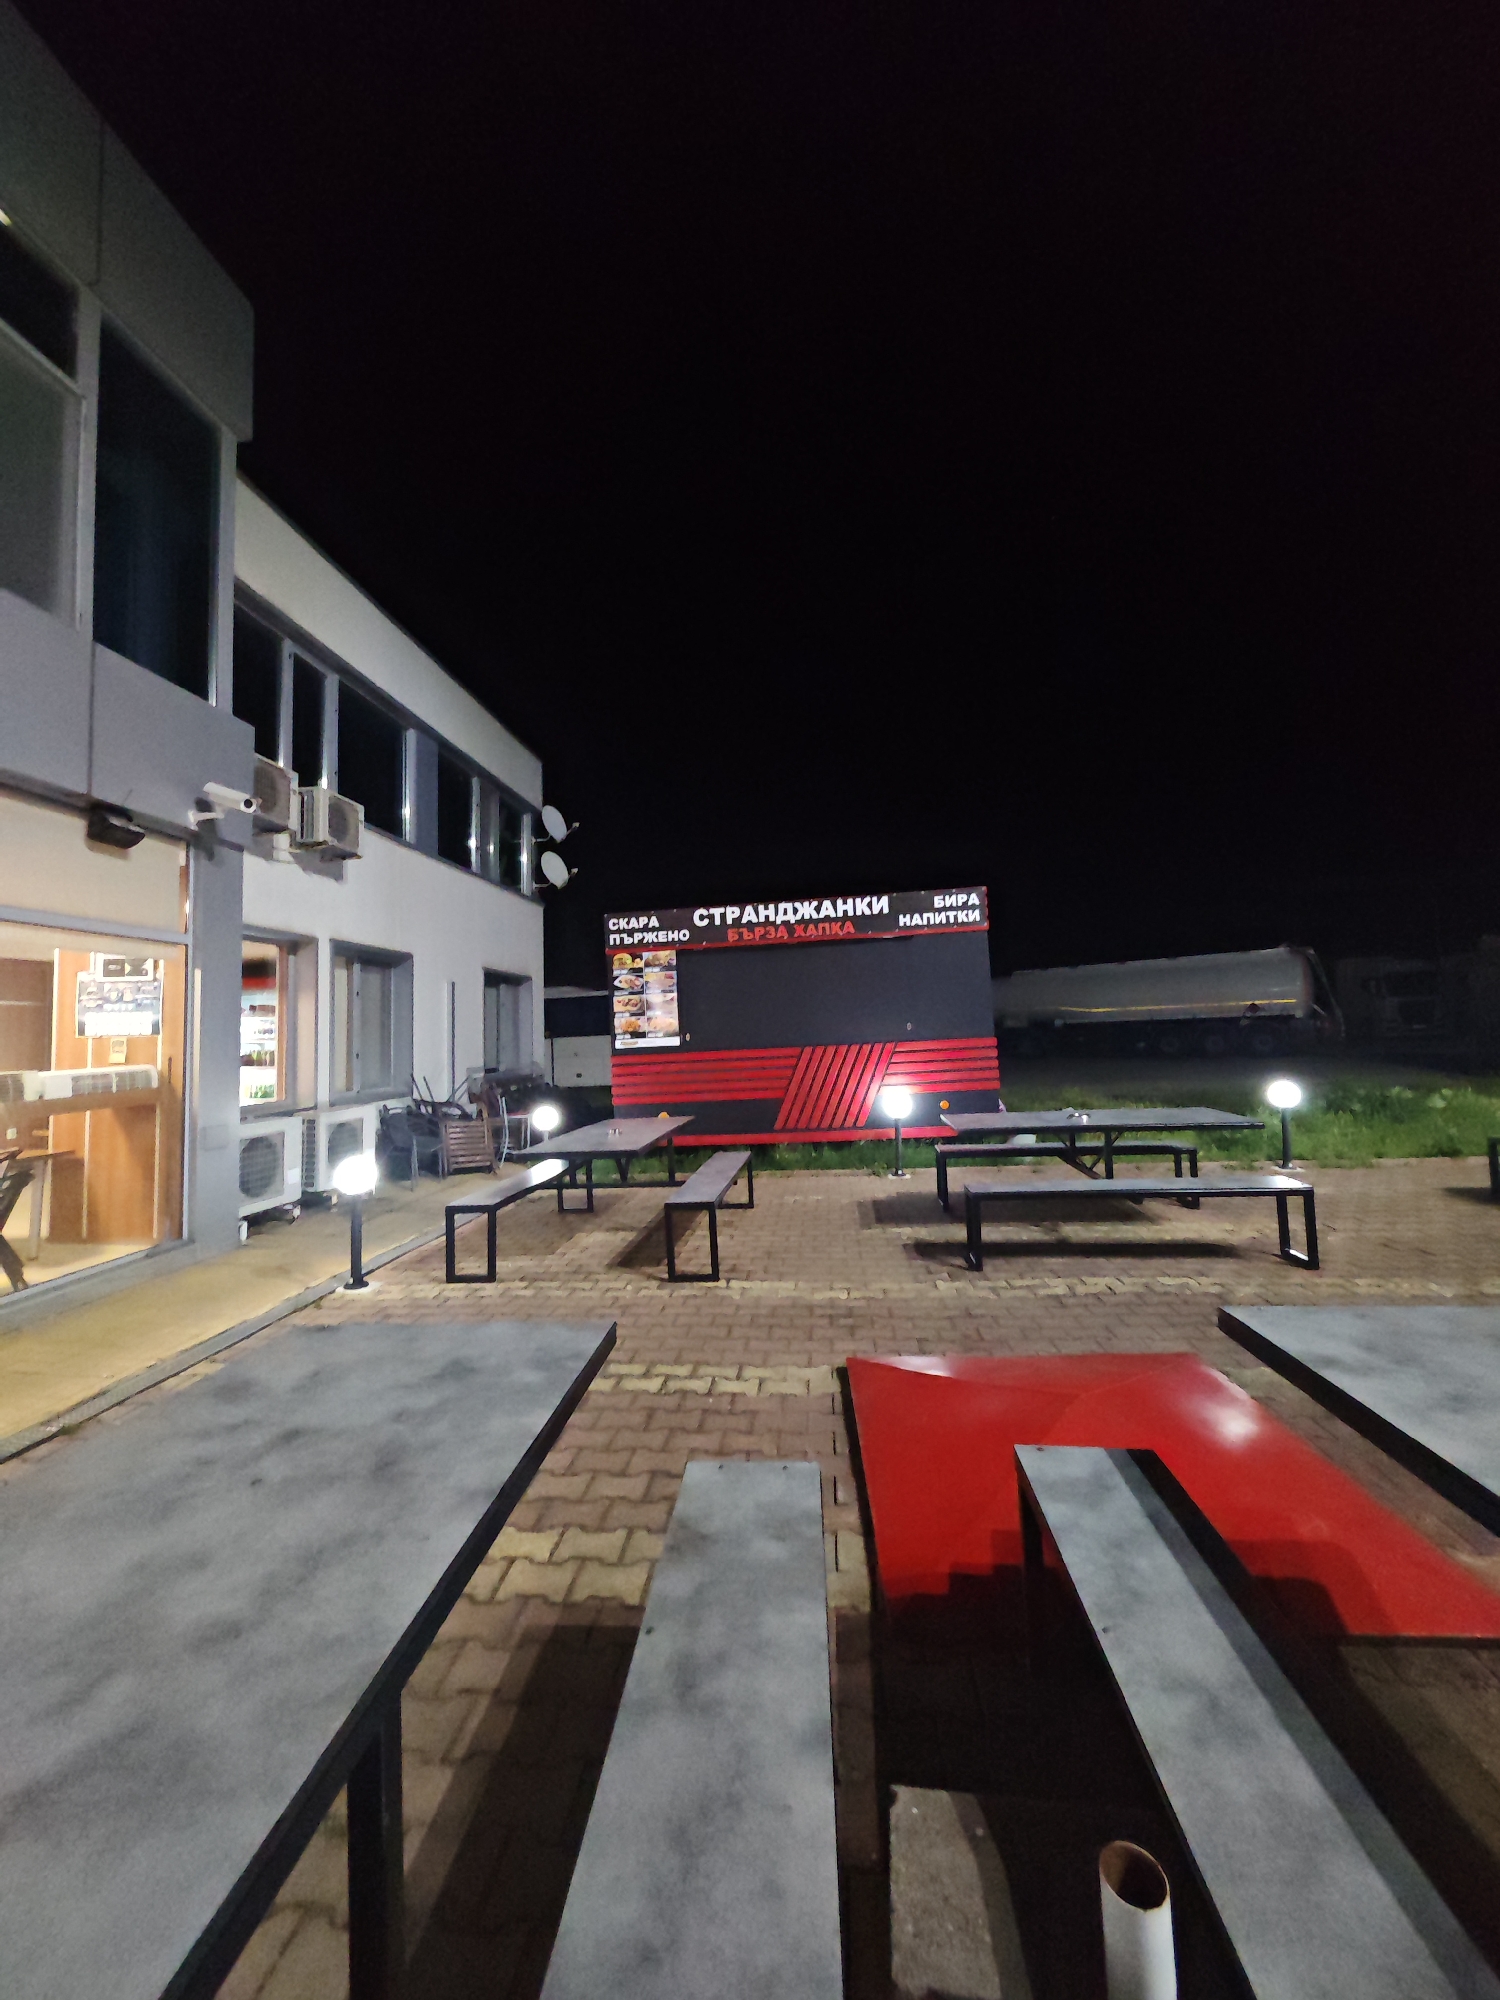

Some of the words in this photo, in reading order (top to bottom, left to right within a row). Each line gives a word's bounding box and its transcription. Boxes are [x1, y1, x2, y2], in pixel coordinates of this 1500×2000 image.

[933, 892, 980, 909] БИРА
[692, 895, 890, 928] СТРАНДЖАНКИ
[898, 908, 981, 928] НАПИТКИ
[608, 916, 659, 931] СКАРА
[726, 924, 788, 942] БЪРЗА
[793, 919, 855, 938] ХАПКА
[609, 929, 690, 946] ПЪРЖЕНО
